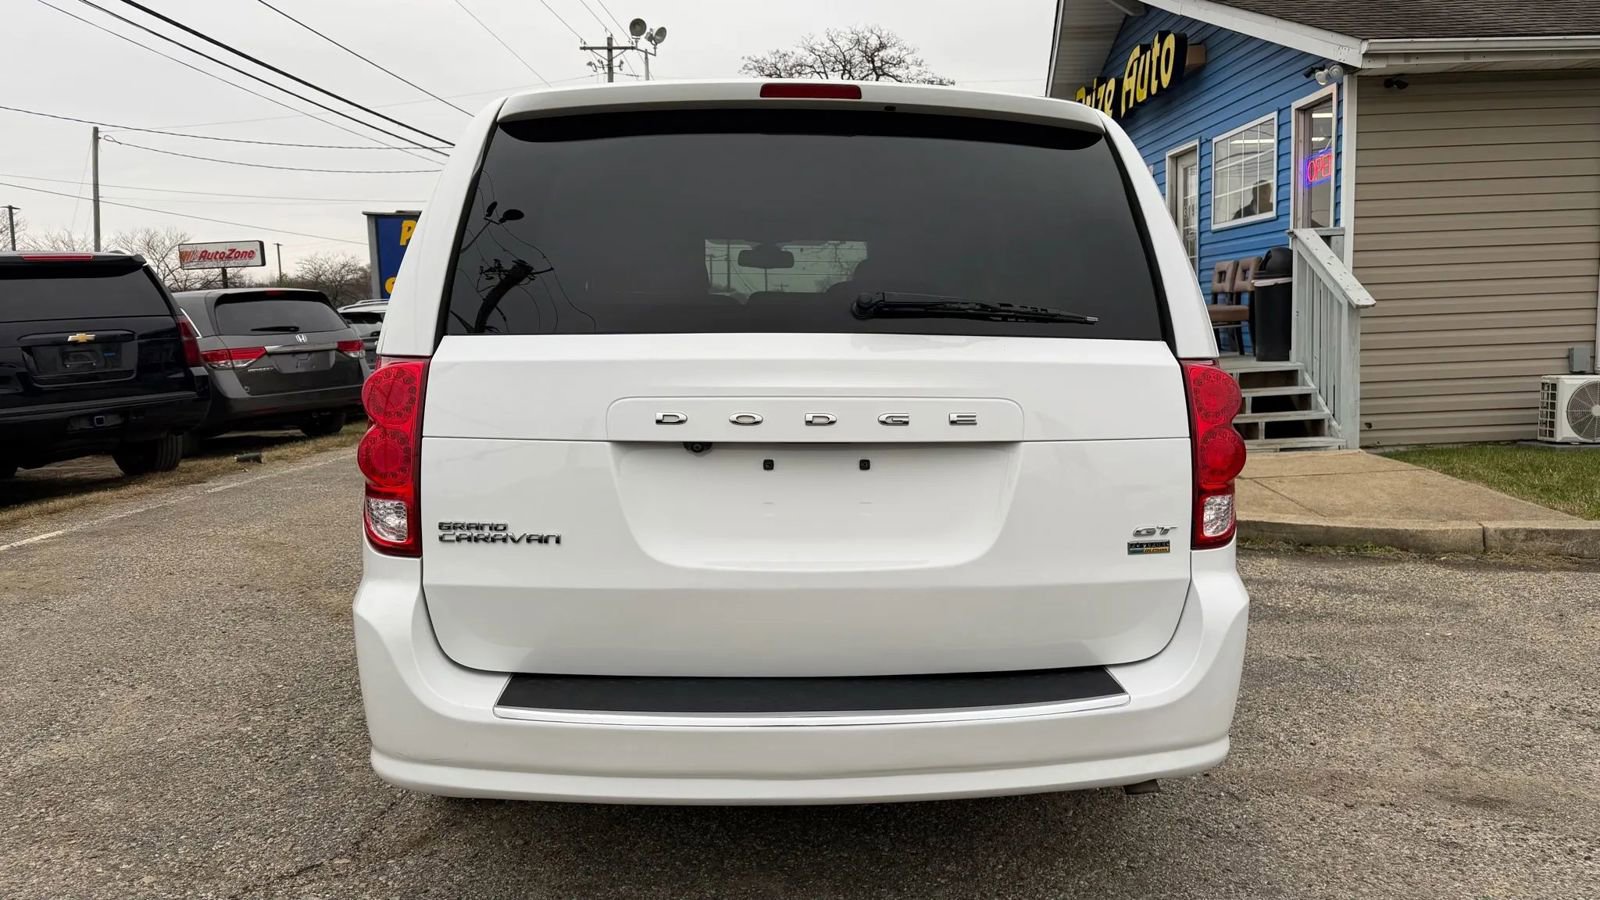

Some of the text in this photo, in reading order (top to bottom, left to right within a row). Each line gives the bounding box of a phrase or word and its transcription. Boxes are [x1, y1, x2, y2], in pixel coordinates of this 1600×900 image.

[1121, 32, 1175, 119] Auto
[200, 248, 257, 261] AutoZone
[655, 411, 978, 426] DODGE
[438, 521, 508, 532] GRAND
[1132, 525, 1178, 538] GT
[438, 532, 561, 544] CARAVAN
